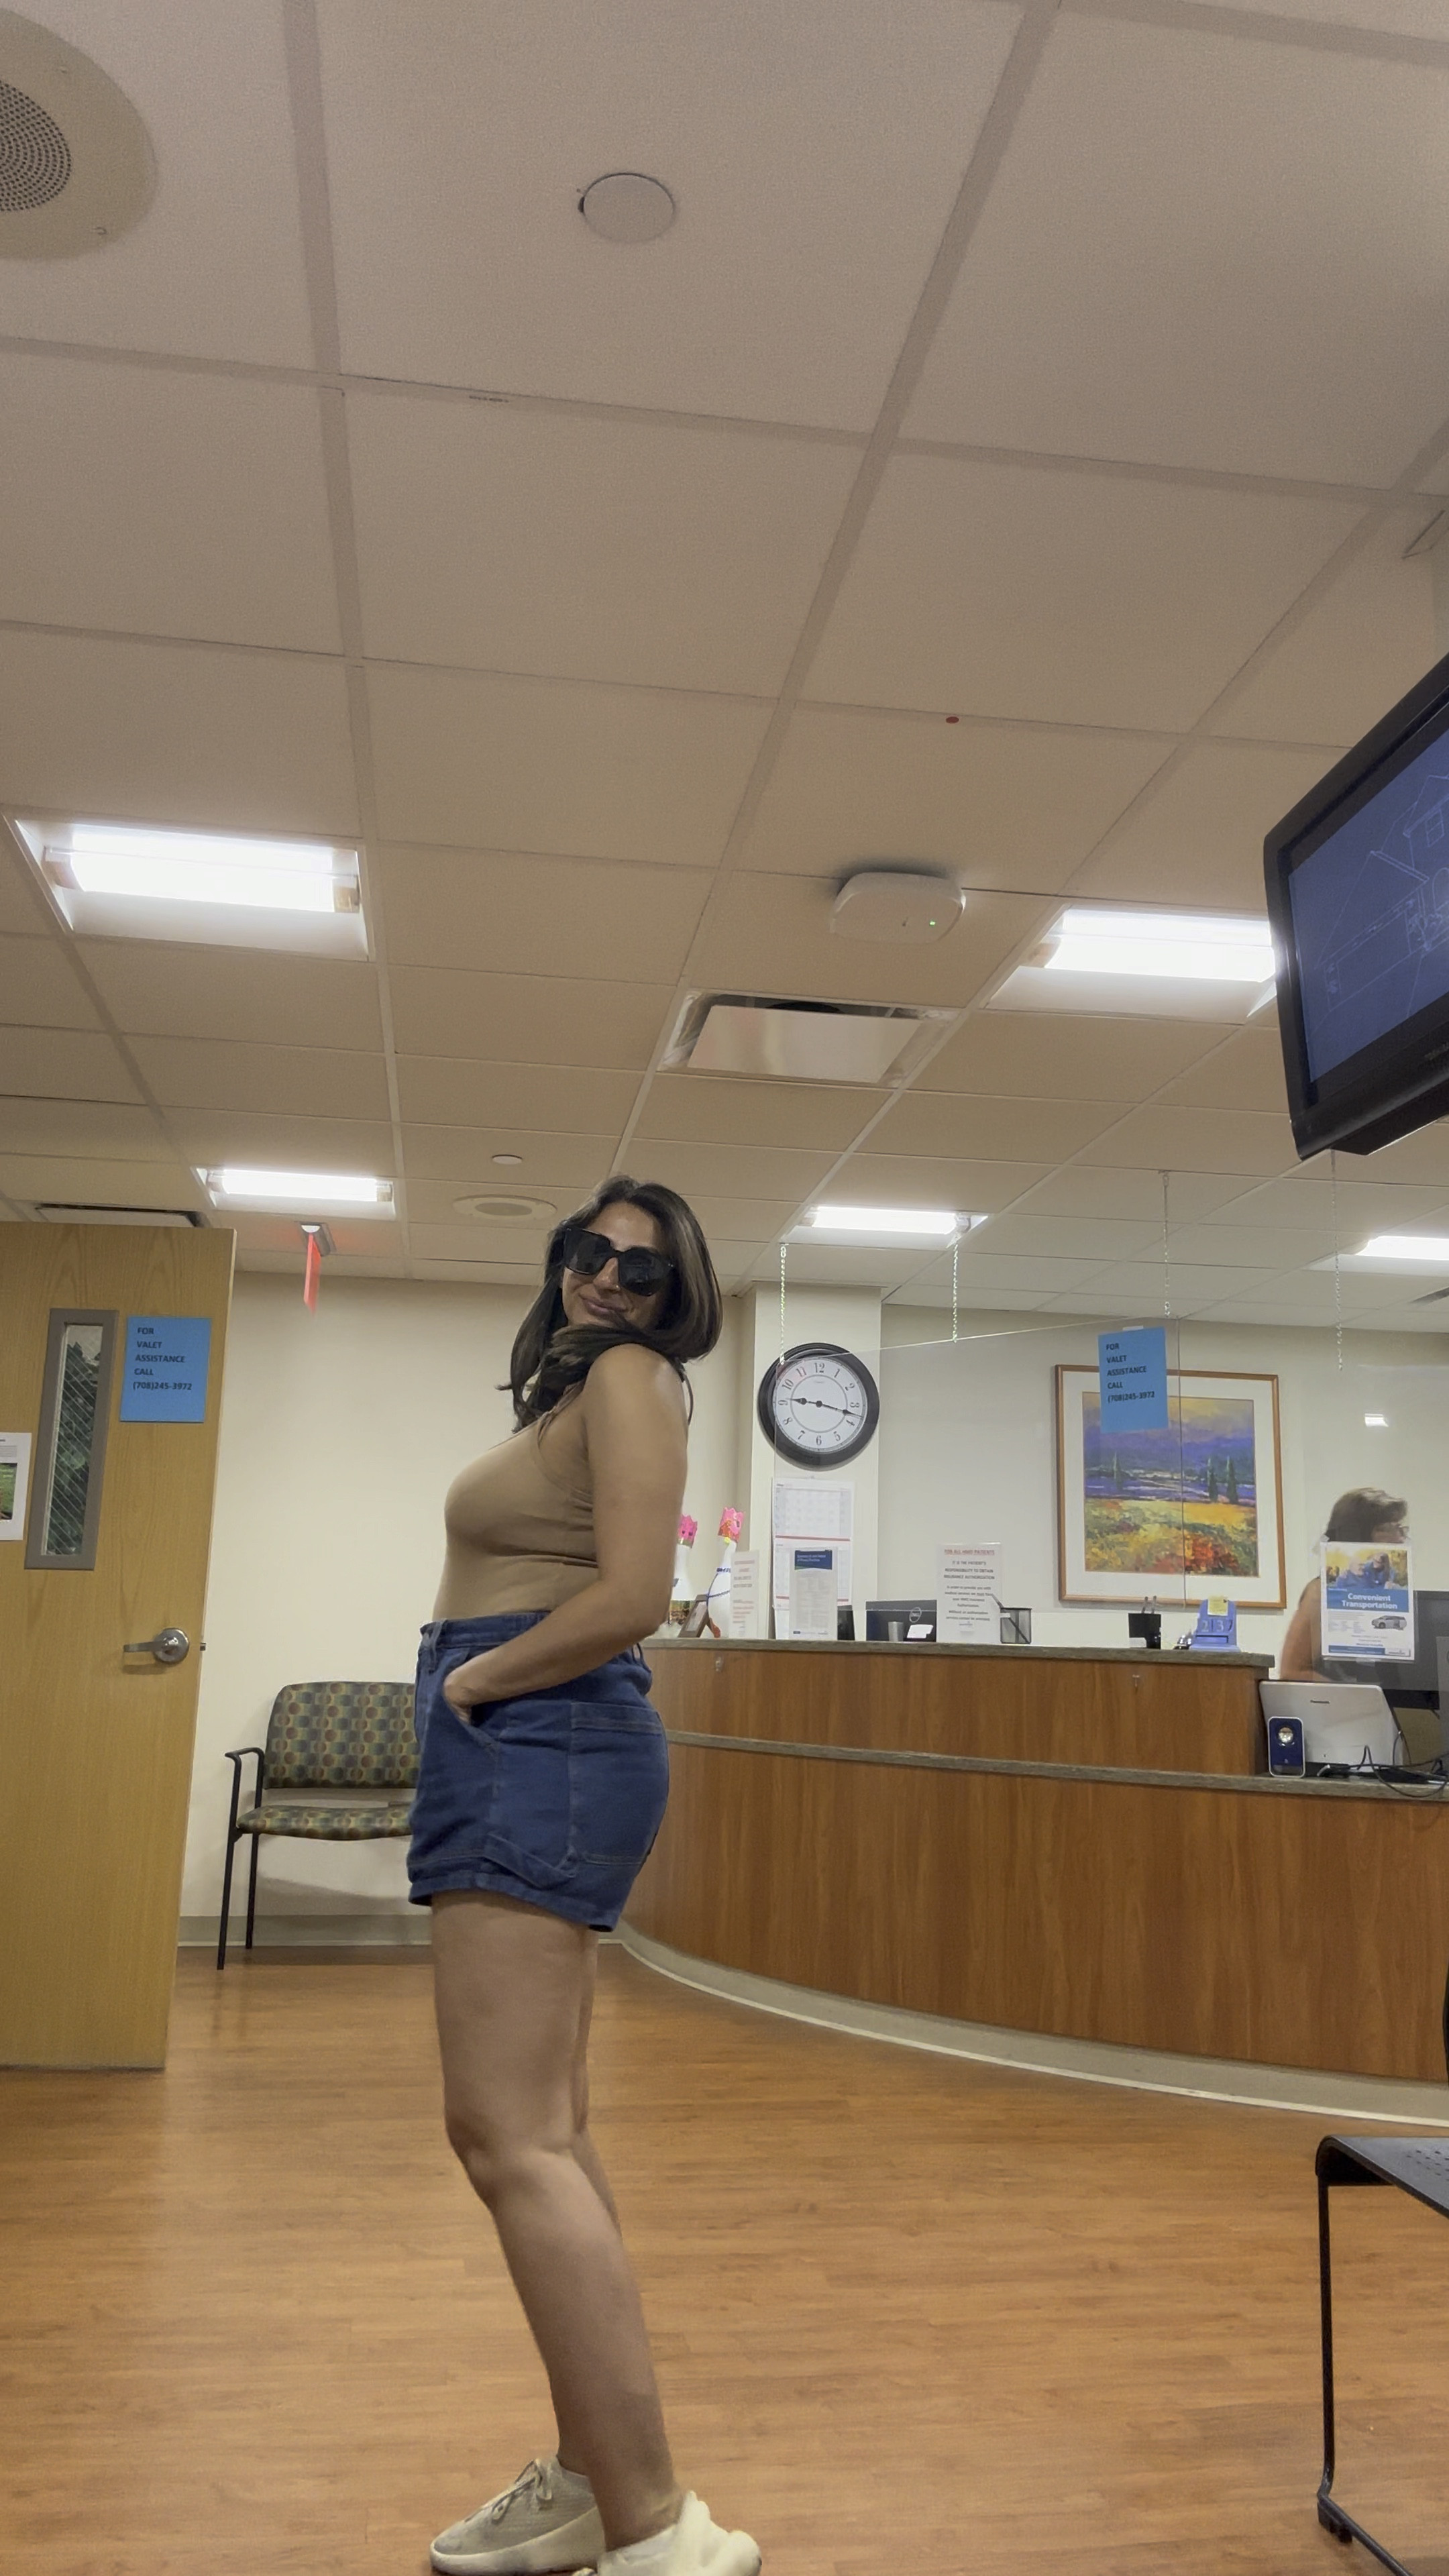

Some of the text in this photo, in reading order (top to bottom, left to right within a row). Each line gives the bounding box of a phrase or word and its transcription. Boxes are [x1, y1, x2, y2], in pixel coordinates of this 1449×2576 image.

[137, 1327, 154, 1335] FOR
[136, 1340, 162, 1348] VALET
[135, 1354, 186, 1363] ASSISTANCE
[1107, 1355, 1127, 1363] VALET
[134, 1368, 154, 1376] CALL
[796, 1366, 807, 1377] 11
[814, 1362, 825, 1373] 12
[1108, 1366, 1147, 1376] ASSISTANCE
[834, 1368, 841, 1378] 1
[133, 1381, 193, 1391] (708)245-3972
[782, 1379, 794, 1391] 10
[845, 1383, 855, 1391] 2
[1108, 1381, 1124, 1389] CALL
[782, 1417, 793, 1426] 8
[846, 1419, 855, 1428] 4
[798, 1430, 806, 1440] 7
[833, 1431, 841, 1442] 5
[816, 1435, 822, 1446] 6
[1347, 1593, 1391, 1601] Convenient
[1342, 1599, 1398, 1609] Transportation
